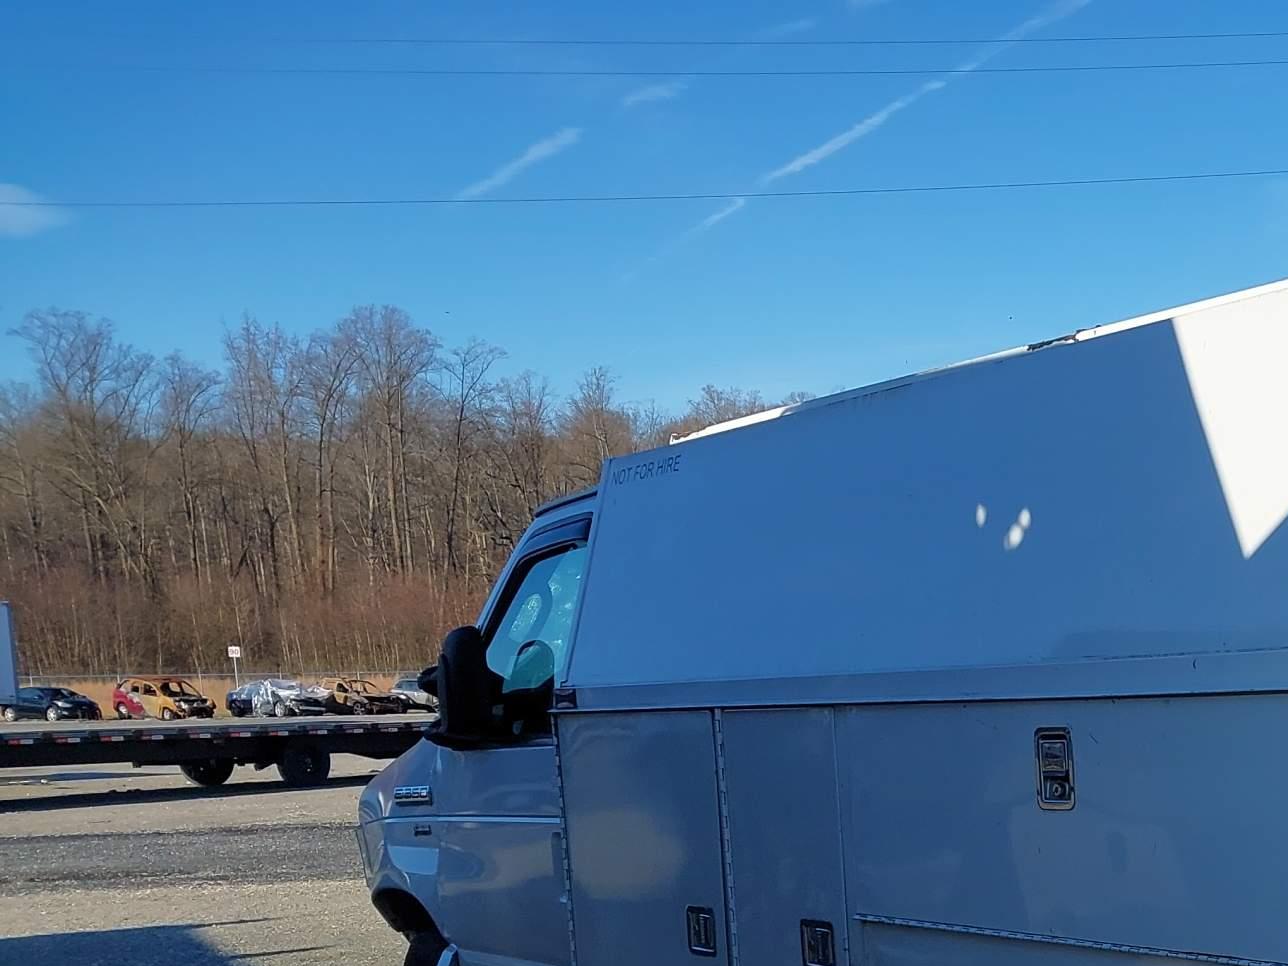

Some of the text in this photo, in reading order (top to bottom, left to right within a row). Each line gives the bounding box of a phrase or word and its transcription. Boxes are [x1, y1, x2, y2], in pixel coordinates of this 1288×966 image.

[611, 454, 683, 486] NOT FOR HIRE
